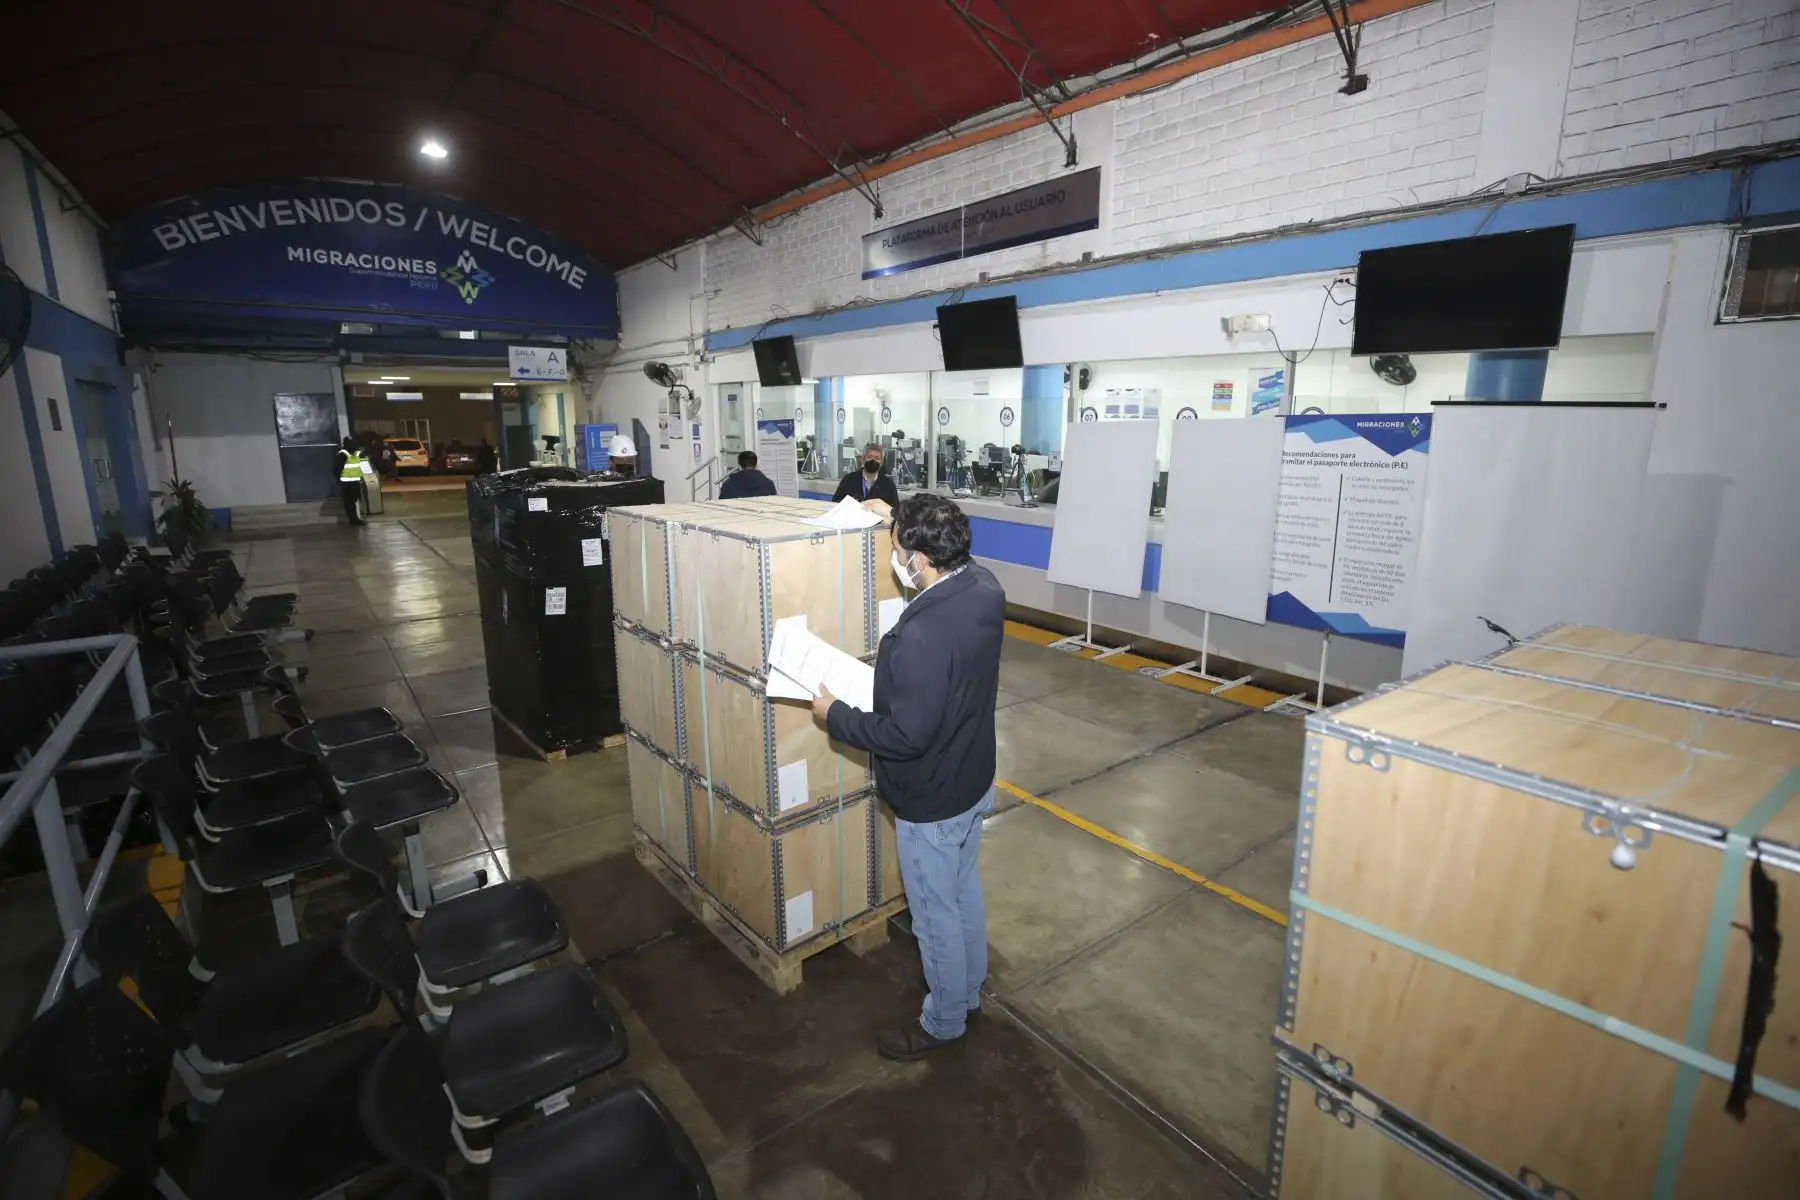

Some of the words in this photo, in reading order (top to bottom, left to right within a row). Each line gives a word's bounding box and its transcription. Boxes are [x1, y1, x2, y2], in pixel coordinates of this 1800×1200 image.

[882, 226, 936, 249] PLATAFORMA
[937, 222, 949, 235] DE
[1000, 206, 1014, 218] AL
[152, 198, 407, 252] BIENVENIDOS
[436, 210, 588, 290] WELCOME
[286, 246, 438, 275] MIGRACIONES
[547, 351, 560, 364] A
[1085, 414, 1094, 422] 07
[1340, 452, 1356, 460] para
[1314, 459, 1348, 469] pasaporte
